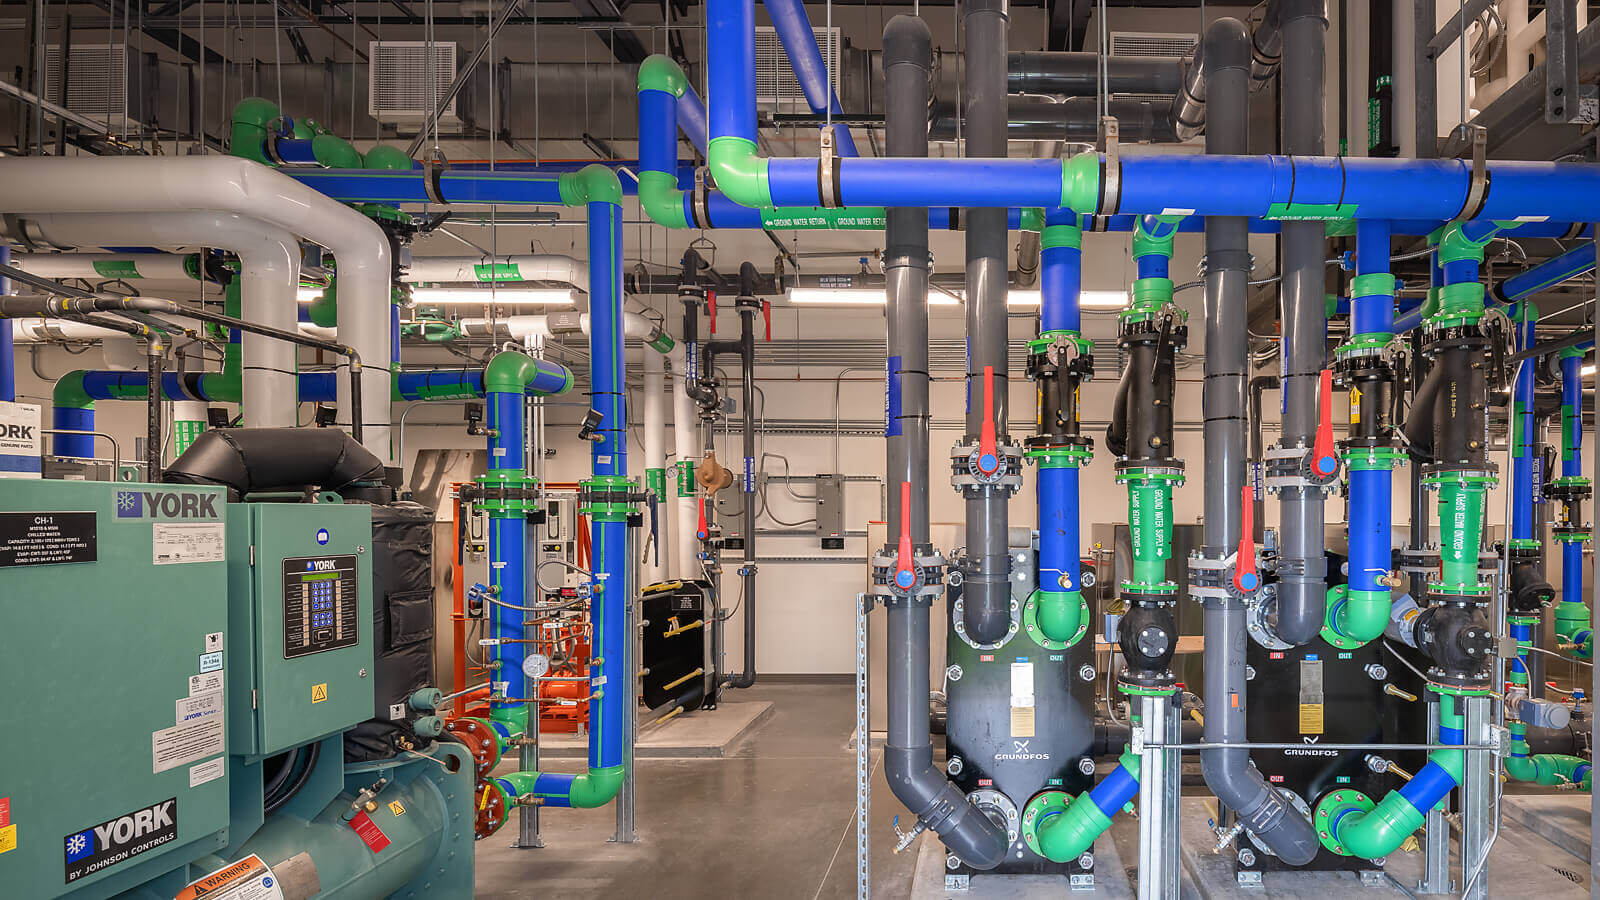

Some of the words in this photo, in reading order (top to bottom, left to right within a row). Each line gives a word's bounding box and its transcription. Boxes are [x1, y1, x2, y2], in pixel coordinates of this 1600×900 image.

[773, 218, 792, 226] GROUND
[793, 218, 808, 226] WATER
[809, 217, 826, 225] RETURN
[838, 217, 856, 226] GROUND
[857, 218, 872, 226] WATER
[0, 424, 33, 440] ORK
[143, 492, 218, 518] YORK
[1132, 490, 1140, 508] SUPPLY
[1154, 489, 1164, 510] GROUND
[1455, 493, 1466, 511] SUPPLY
[34, 516, 53, 525] CH-1
[1132, 509, 1140, 526] WATER
[1155, 511, 1164, 528] WATER
[1454, 512, 1465, 529] WATER
[1133, 527, 1141, 548] GROUND
[1155, 529, 1164, 547] SUPPLY
[1453, 530, 1465, 550] GROUND
[313, 560, 336, 570] YORK
[94, 801, 172, 851] YORK
[69, 869, 82, 881] BY
[85, 851, 128, 875] JOHNSON
[131, 832, 175, 855] CONTROLS
[206, 862, 251, 888] WARNING
